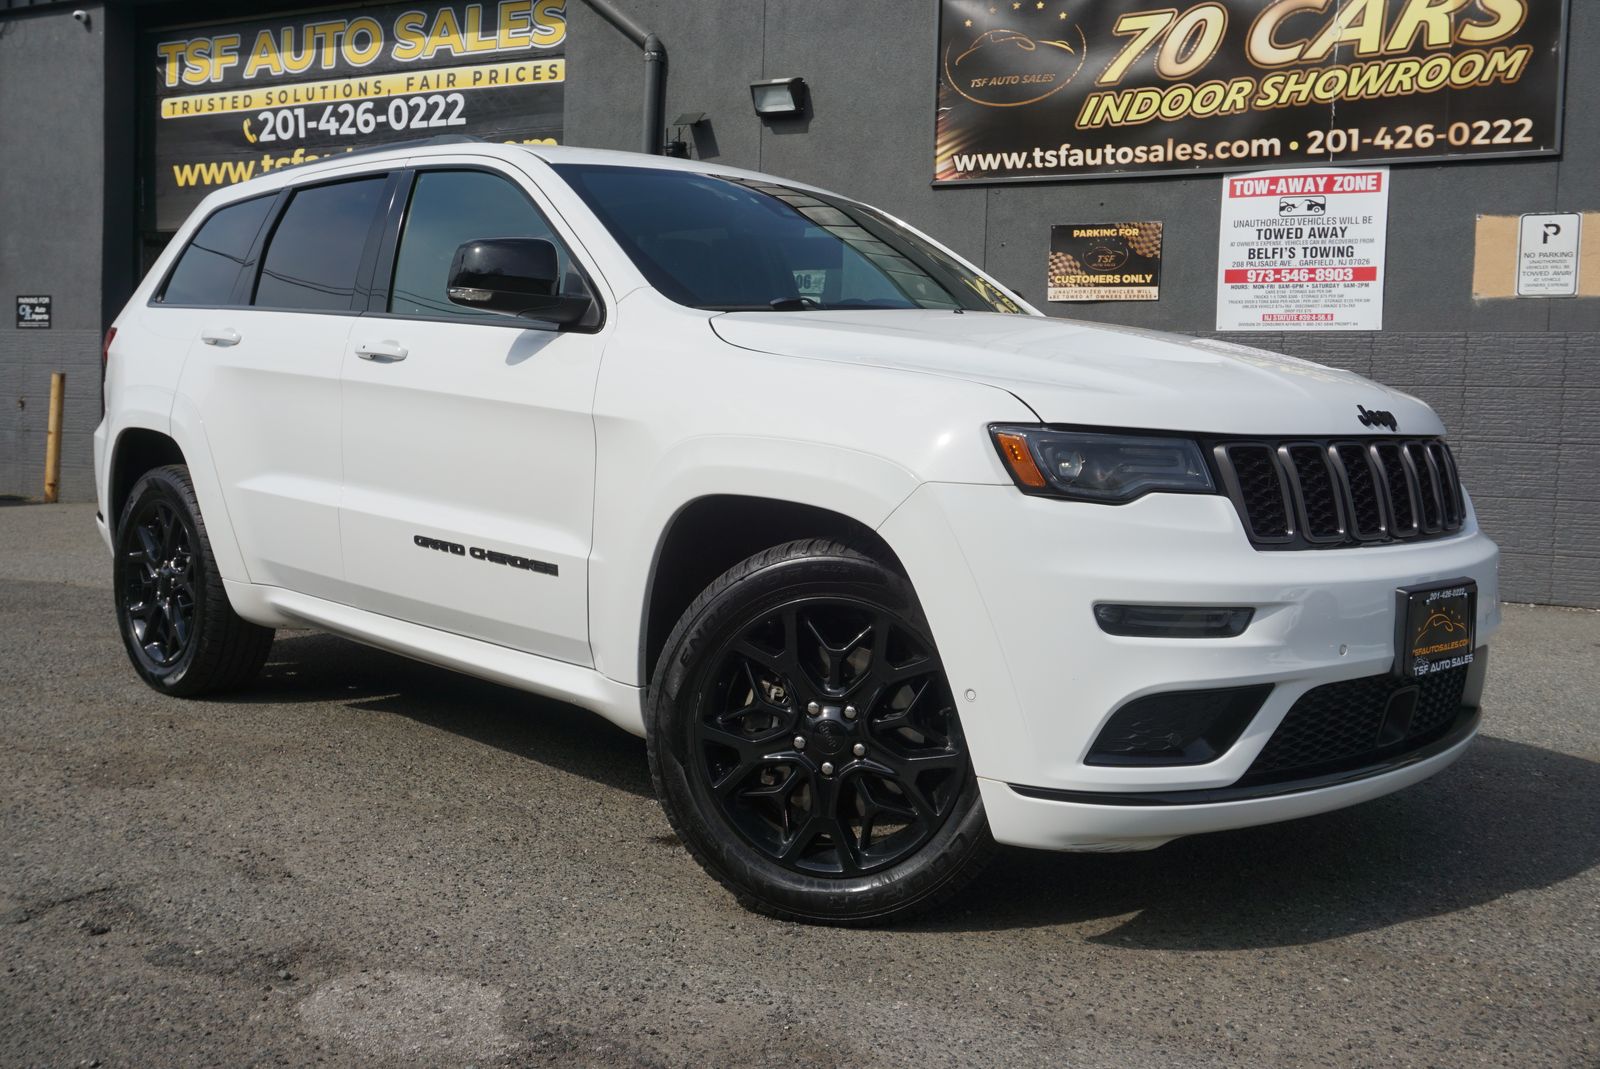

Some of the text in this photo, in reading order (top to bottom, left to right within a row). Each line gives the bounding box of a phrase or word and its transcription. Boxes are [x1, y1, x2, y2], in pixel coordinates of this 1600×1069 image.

[158, 0, 567, 87] TSF AUTO SALES
[1095, 0, 1528, 89] 70 CARS
[169, 64, 559, 116] TRUSTED SOLUTIONS, FAIR PRICES
[970, 73, 1055, 88] TSF AUTO SALES
[1075, 44, 1533, 130] INDOOR SHOWROOM
[258, 93, 467, 142] 201-426-0222
[952, 117, 1533, 173] www.tsfautosales.com 201-426-0222
[1234, 175, 1377, 196] TOW-AWAY ZONE
[1233, 216, 1373, 228] UNAUTHORIZED VEHICLES WILL BE
[1073, 228, 1140, 238] PARKING FOR
[1256, 226, 1348, 240] TOWED AWAY
[1097, 255, 1117, 263] TSF
[1248, 245, 1354, 259] BELFI'S TOWING
[1054, 274, 1153, 284] CUSTOMERS ONLY
[1247, 269, 1353, 282] 973-546-8903
[1357, 404, 1398, 432] Jeep
[413, 535, 559, 577] GRAND CHEROKEE
[1414, 654, 1474, 676] TSF AUTO SALES
